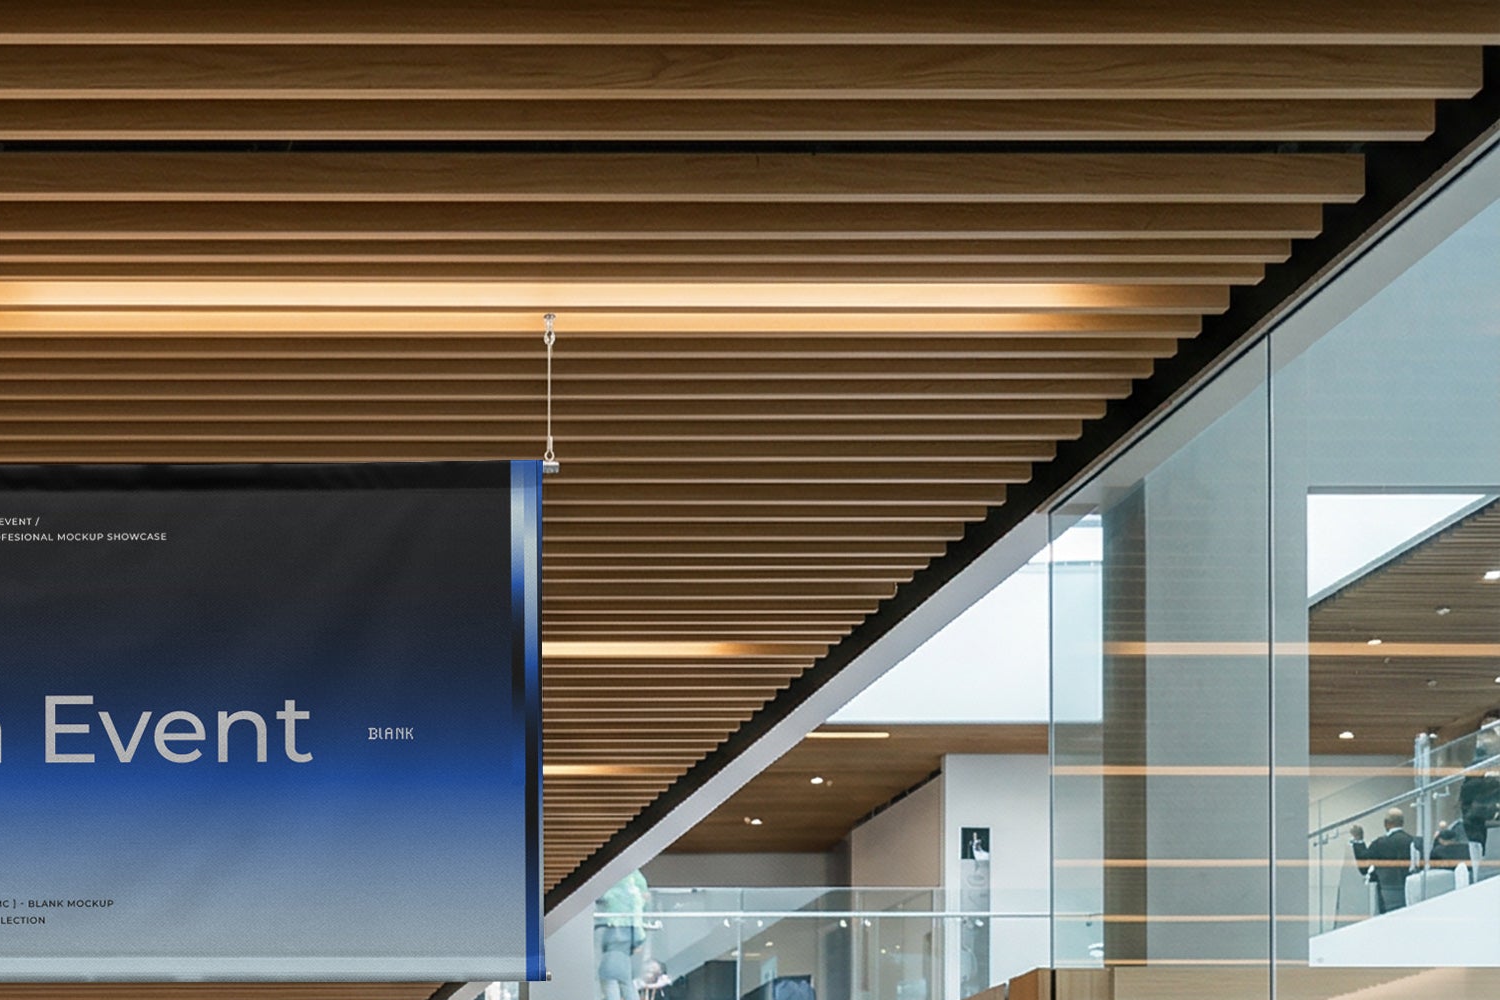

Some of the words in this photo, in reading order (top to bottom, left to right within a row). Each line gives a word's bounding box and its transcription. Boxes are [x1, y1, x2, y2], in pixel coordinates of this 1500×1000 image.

[34, 517, 40, 527] /
[57, 532, 104, 541] MOCKUP
[106, 532, 167, 541] SHOWCASE
[44, 695, 314, 764] Event
[27, 899, 64, 908] BLANK
[67, 899, 114, 908] MOCKUP
